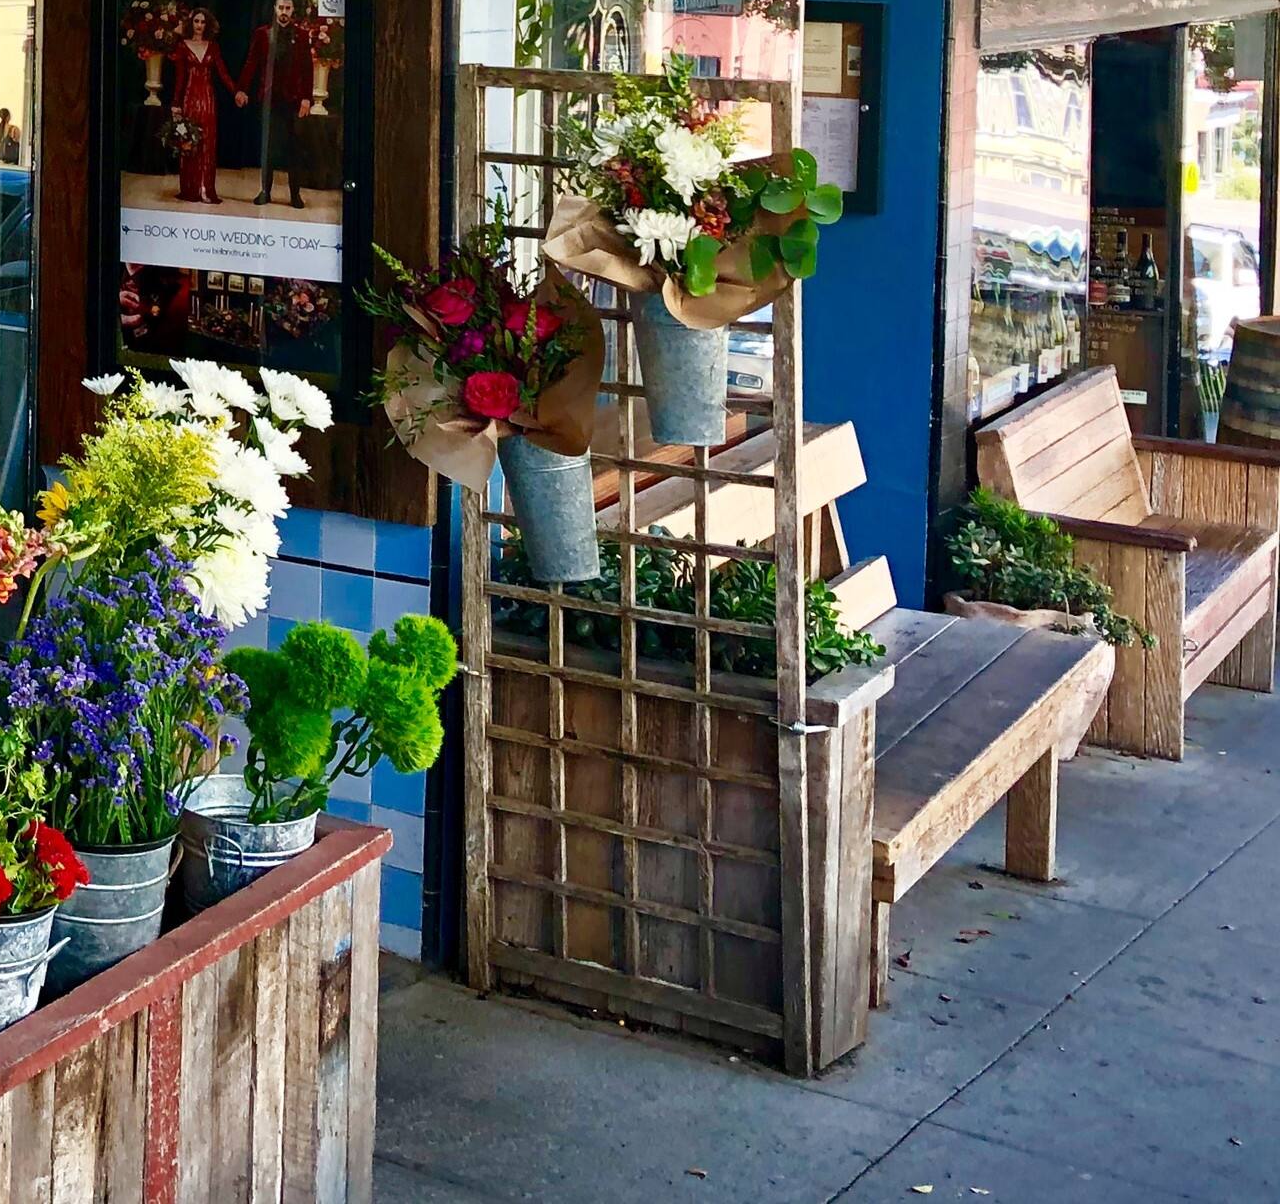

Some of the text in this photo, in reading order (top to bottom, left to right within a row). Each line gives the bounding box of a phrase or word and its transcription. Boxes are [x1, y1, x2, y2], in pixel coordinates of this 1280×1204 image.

[144, 224, 320, 251] BOOK YOUR WEDDING TODAY
